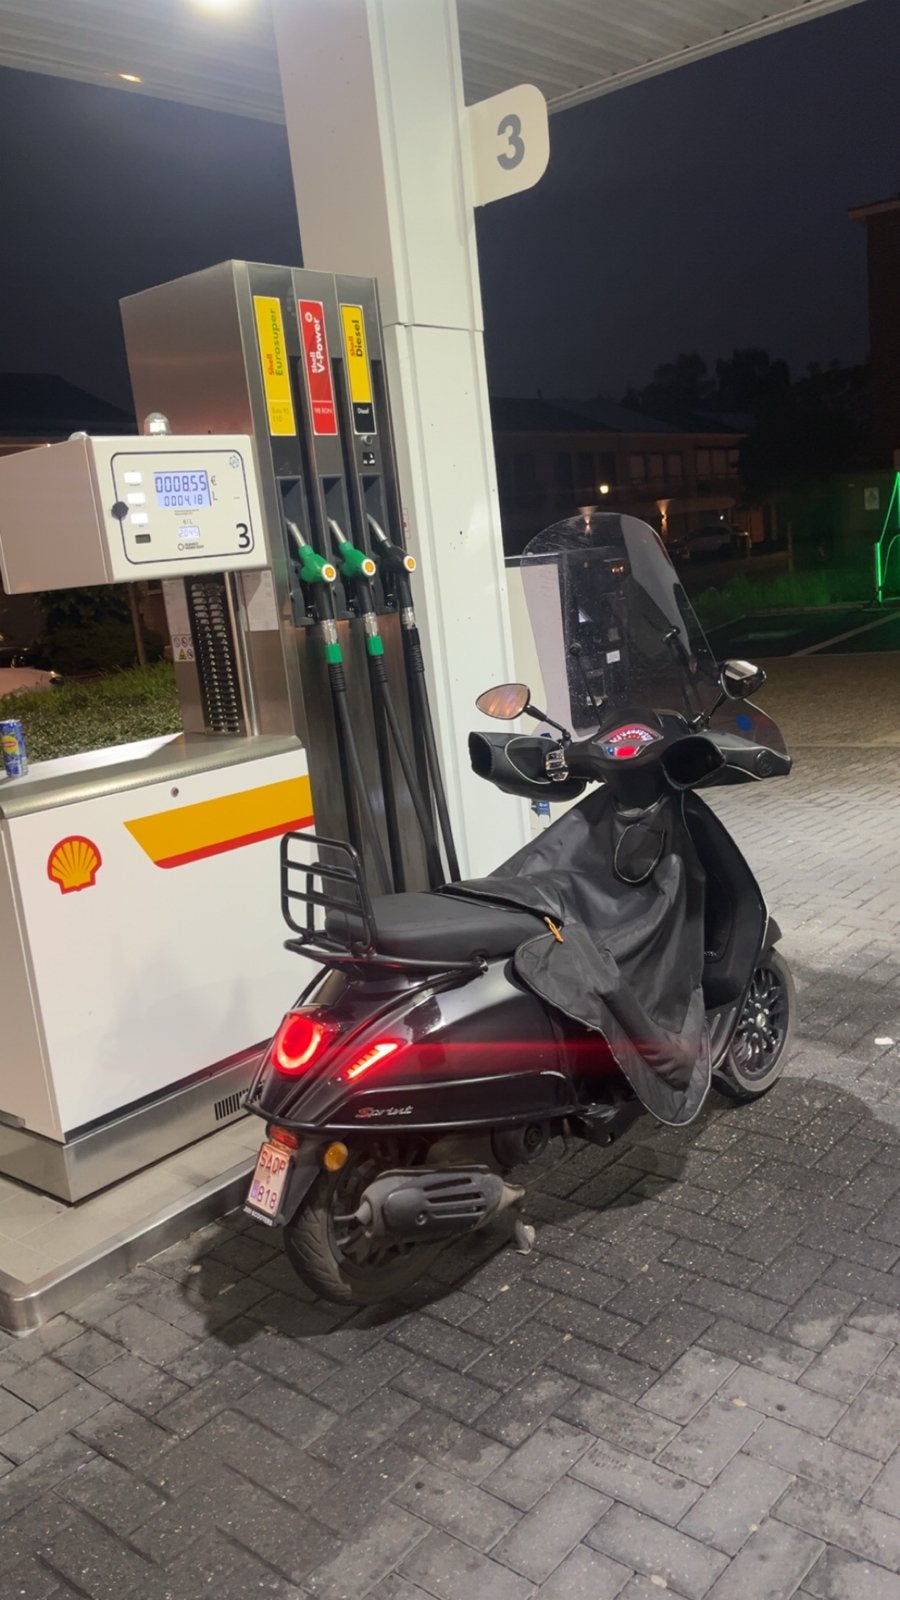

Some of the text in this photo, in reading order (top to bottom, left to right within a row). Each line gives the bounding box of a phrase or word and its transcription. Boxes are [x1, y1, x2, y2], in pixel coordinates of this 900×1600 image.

[496, 113, 526, 171] 3
[270, 308, 283, 376] Eurosuper
[352, 320, 363, 357] Diesel
[310, 351, 318, 374] Shell
[211, 475, 217, 486] €
[236, 523, 251, 548] 3
[355, 1105, 415, 1118] Sprint
[257, 1186, 278, 1209] 818
